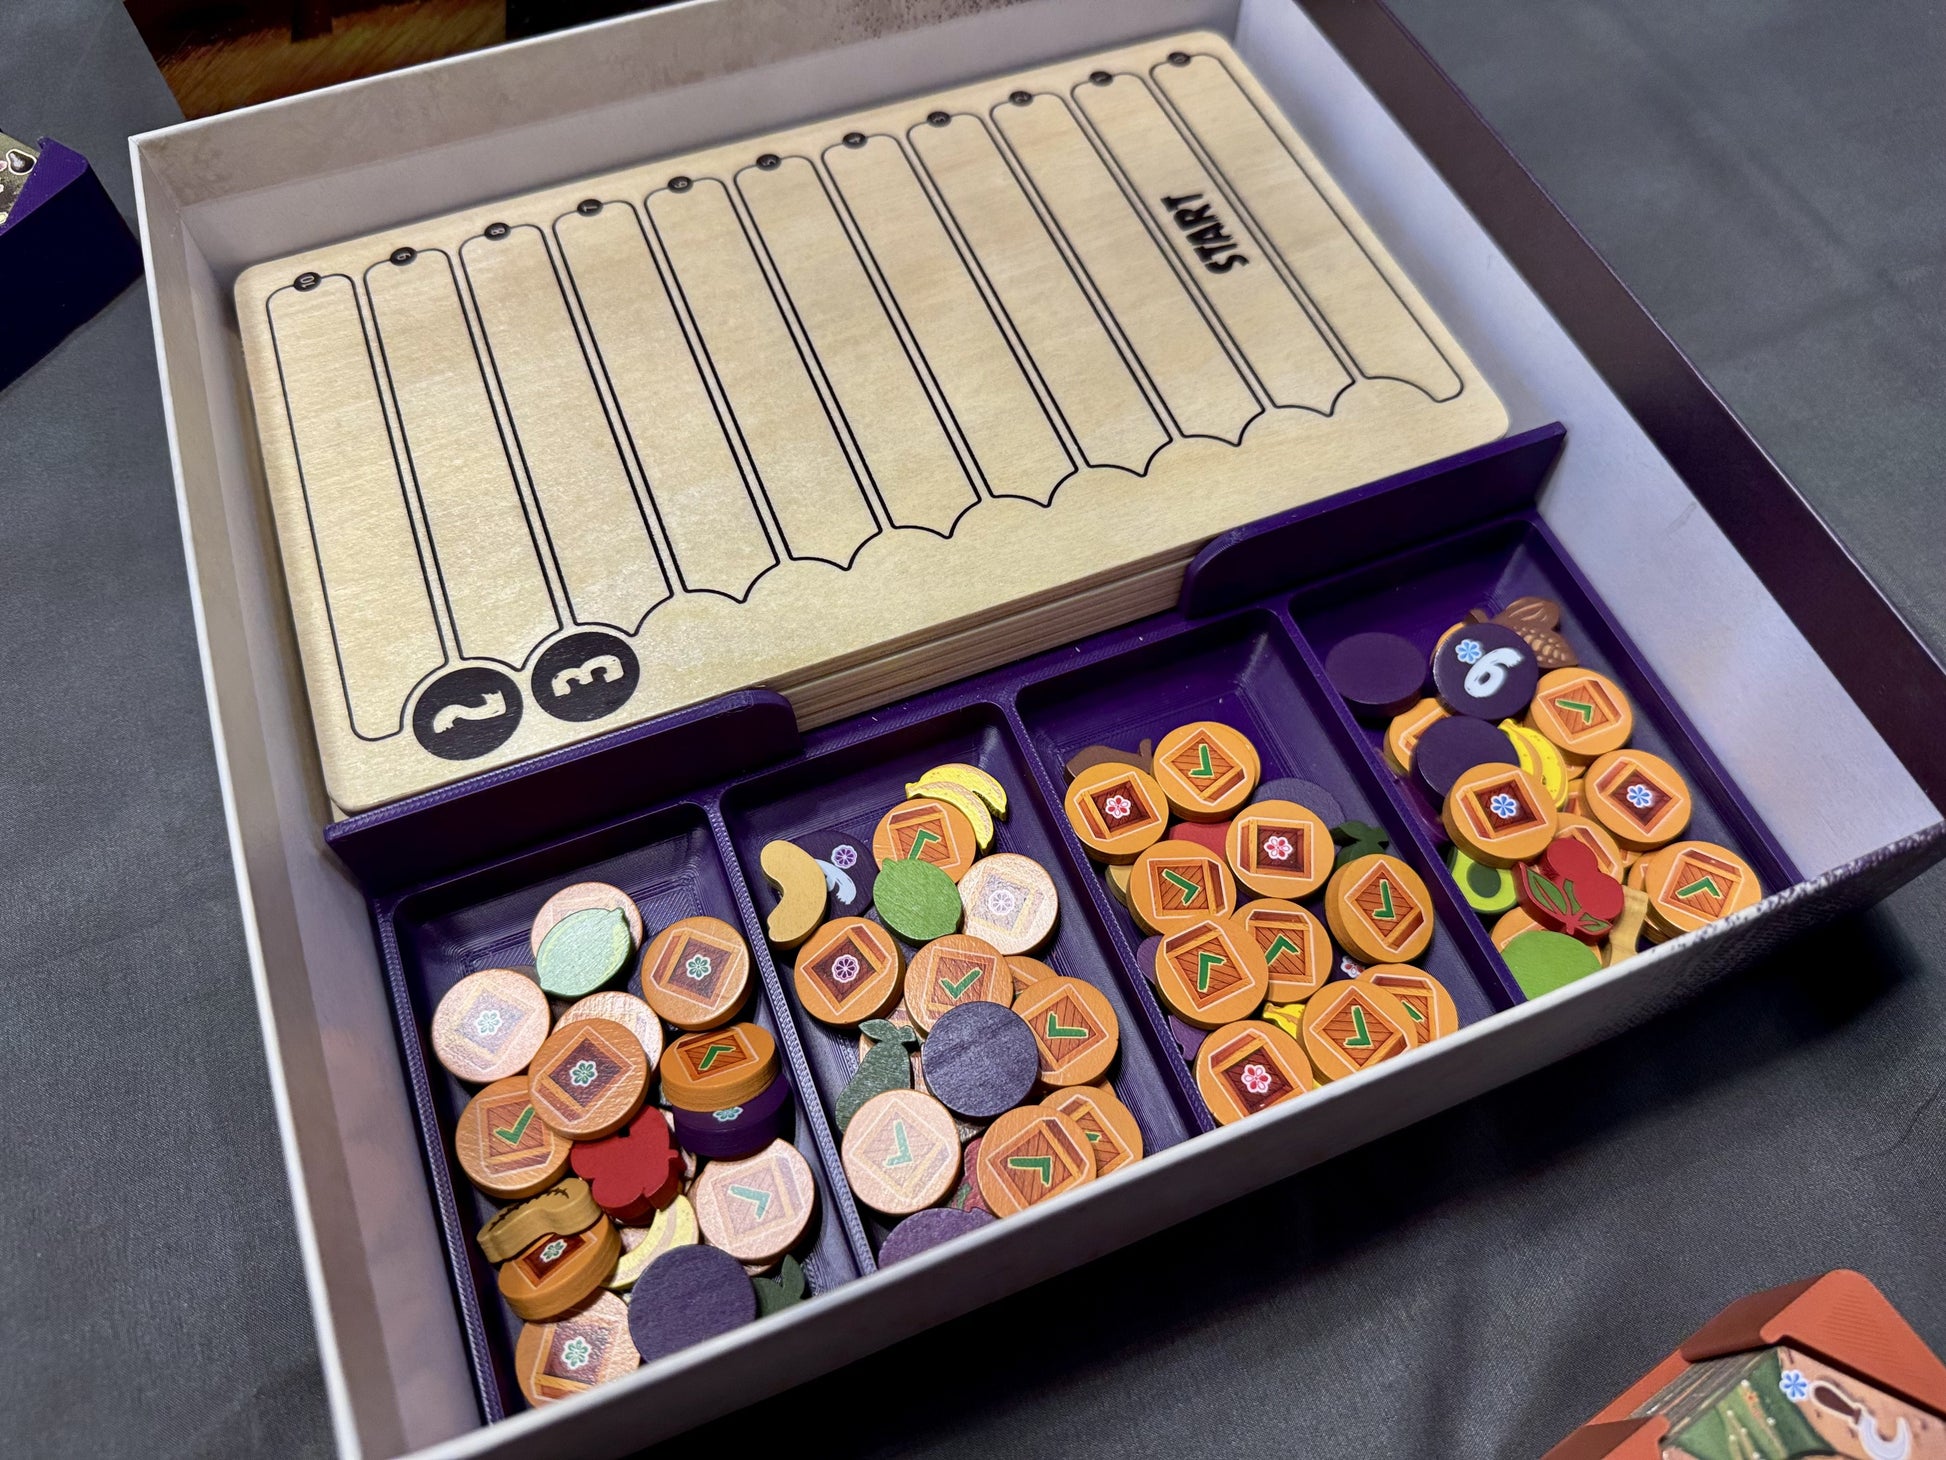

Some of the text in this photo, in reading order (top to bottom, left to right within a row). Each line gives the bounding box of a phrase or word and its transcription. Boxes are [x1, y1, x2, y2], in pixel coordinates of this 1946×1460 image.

[1160, 193, 1250, 275] START
[299, 274, 316, 288] 10
[551, 654, 624, 697] 3
[1463, 646, 1524, 698] 6
[433, 689, 507, 734] 2
